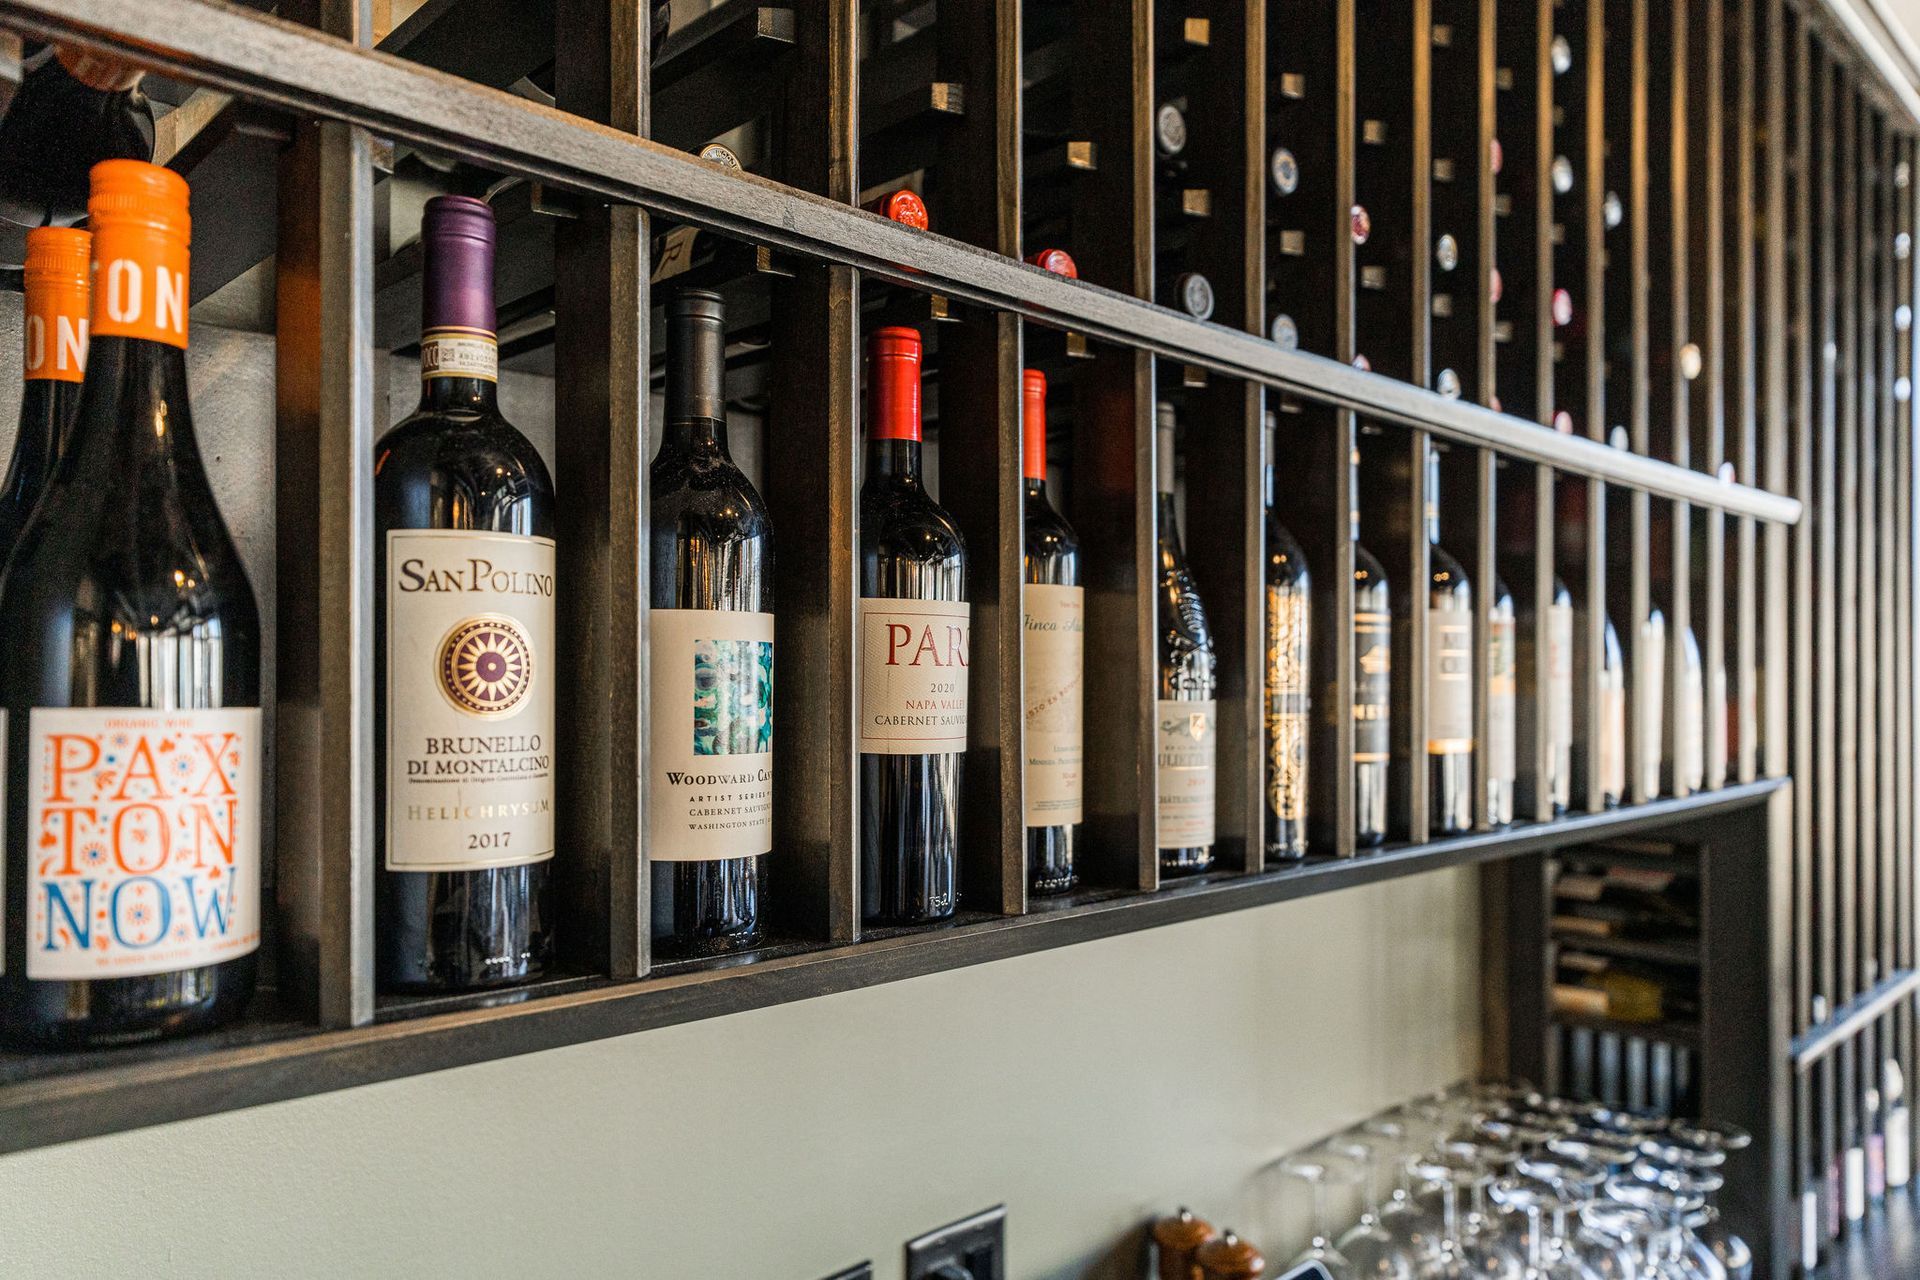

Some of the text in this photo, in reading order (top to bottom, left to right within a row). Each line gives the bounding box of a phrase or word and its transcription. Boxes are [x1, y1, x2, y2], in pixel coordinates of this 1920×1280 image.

[107, 258, 185, 334] ON
[26, 315, 89, 373] ON
[399, 559, 553, 597] SAN POLINO
[931, 683, 955, 693] 2020
[906, 700, 937, 710] NAPA
[875, 715, 938, 726] CABERNET
[426, 735, 541, 755] BRUNELLO
[47, 732, 237, 803] PAX
[407, 755, 549, 775] DI MONTALCINO
[666, 771, 755, 785] WOODWARD
[690, 794, 732, 803] ARTIST
[689, 806, 742, 817] CABERNET
[688, 820, 747, 831] WASHINGTON
[42, 800, 239, 875] TON
[468, 832, 511, 850] 2017
[40, 867, 236, 951] NOW
